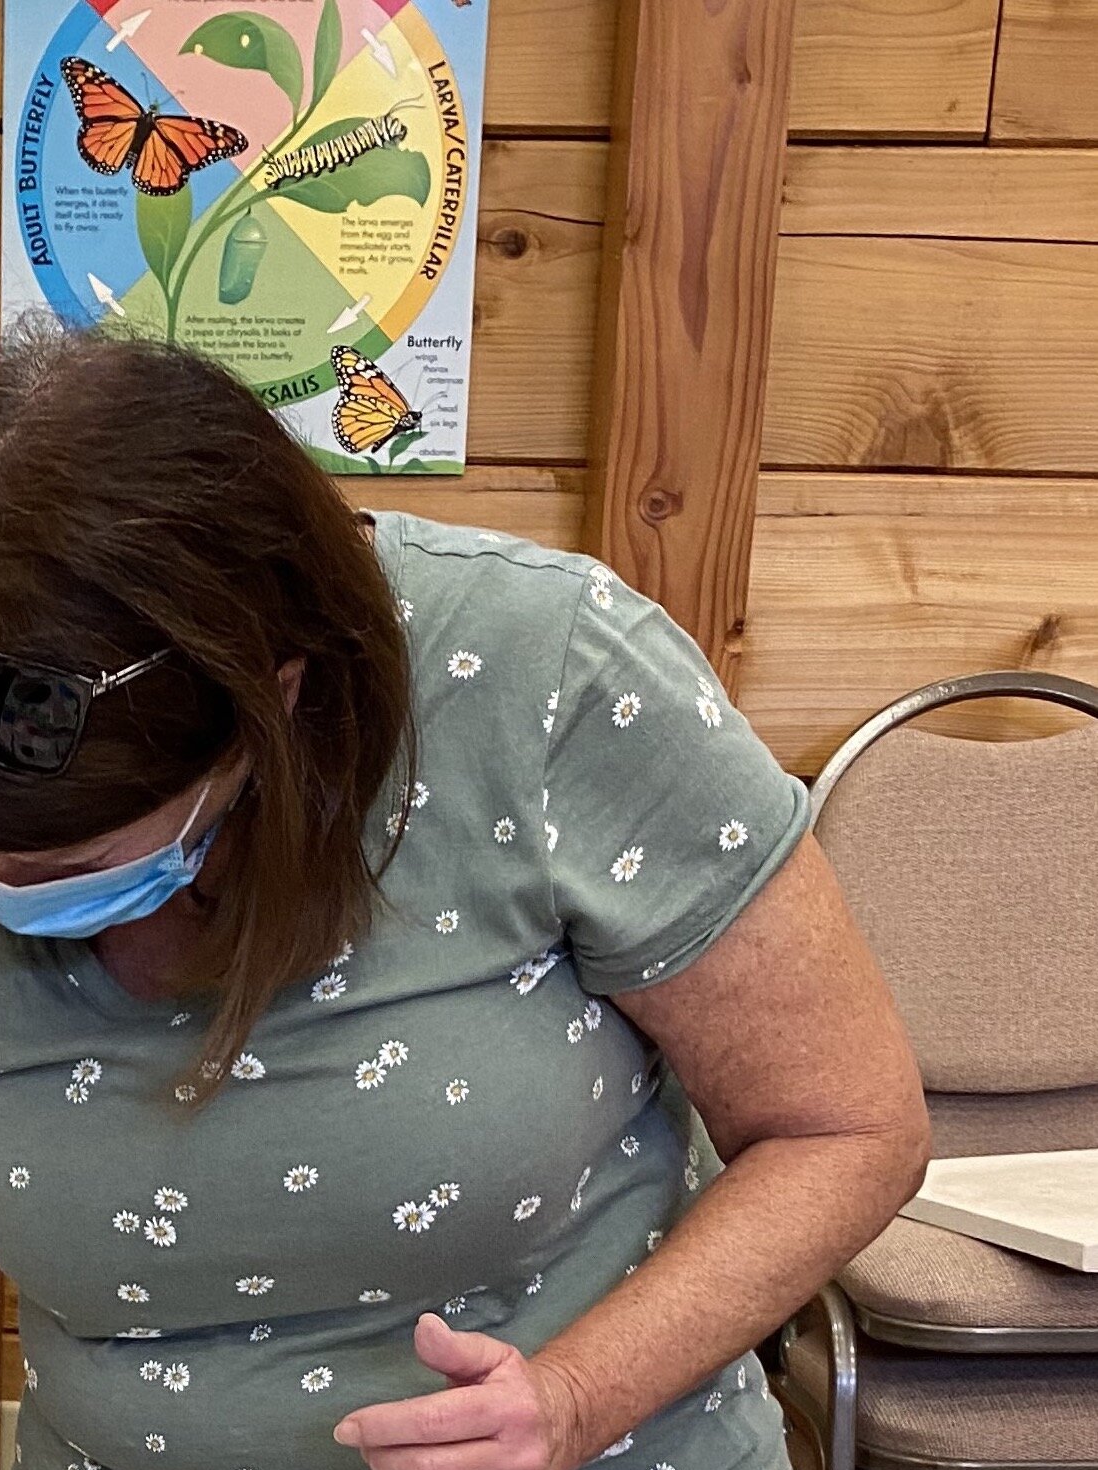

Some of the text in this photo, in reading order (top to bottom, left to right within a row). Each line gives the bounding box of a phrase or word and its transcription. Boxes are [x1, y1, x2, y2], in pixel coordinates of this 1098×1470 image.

[19, 72, 54, 193] BUTTERFLY
[95, 186, 128, 197] butterfly
[73, 211, 90, 219] and
[99, 212, 124, 221] ready
[342, 216, 355, 226] The
[358, 217, 378, 226] larva
[22, 202, 53, 266] ADULT
[362, 230, 374, 239] the
[376, 232, 392, 240] egg
[393, 230, 410, 239] and
[368, 254, 379, 262] As
[240, 316, 253, 324] the
[242, 340, 255, 348] the
[407, 335, 463, 351] Butterfly
[262, 374, 320, 405] SALIS
